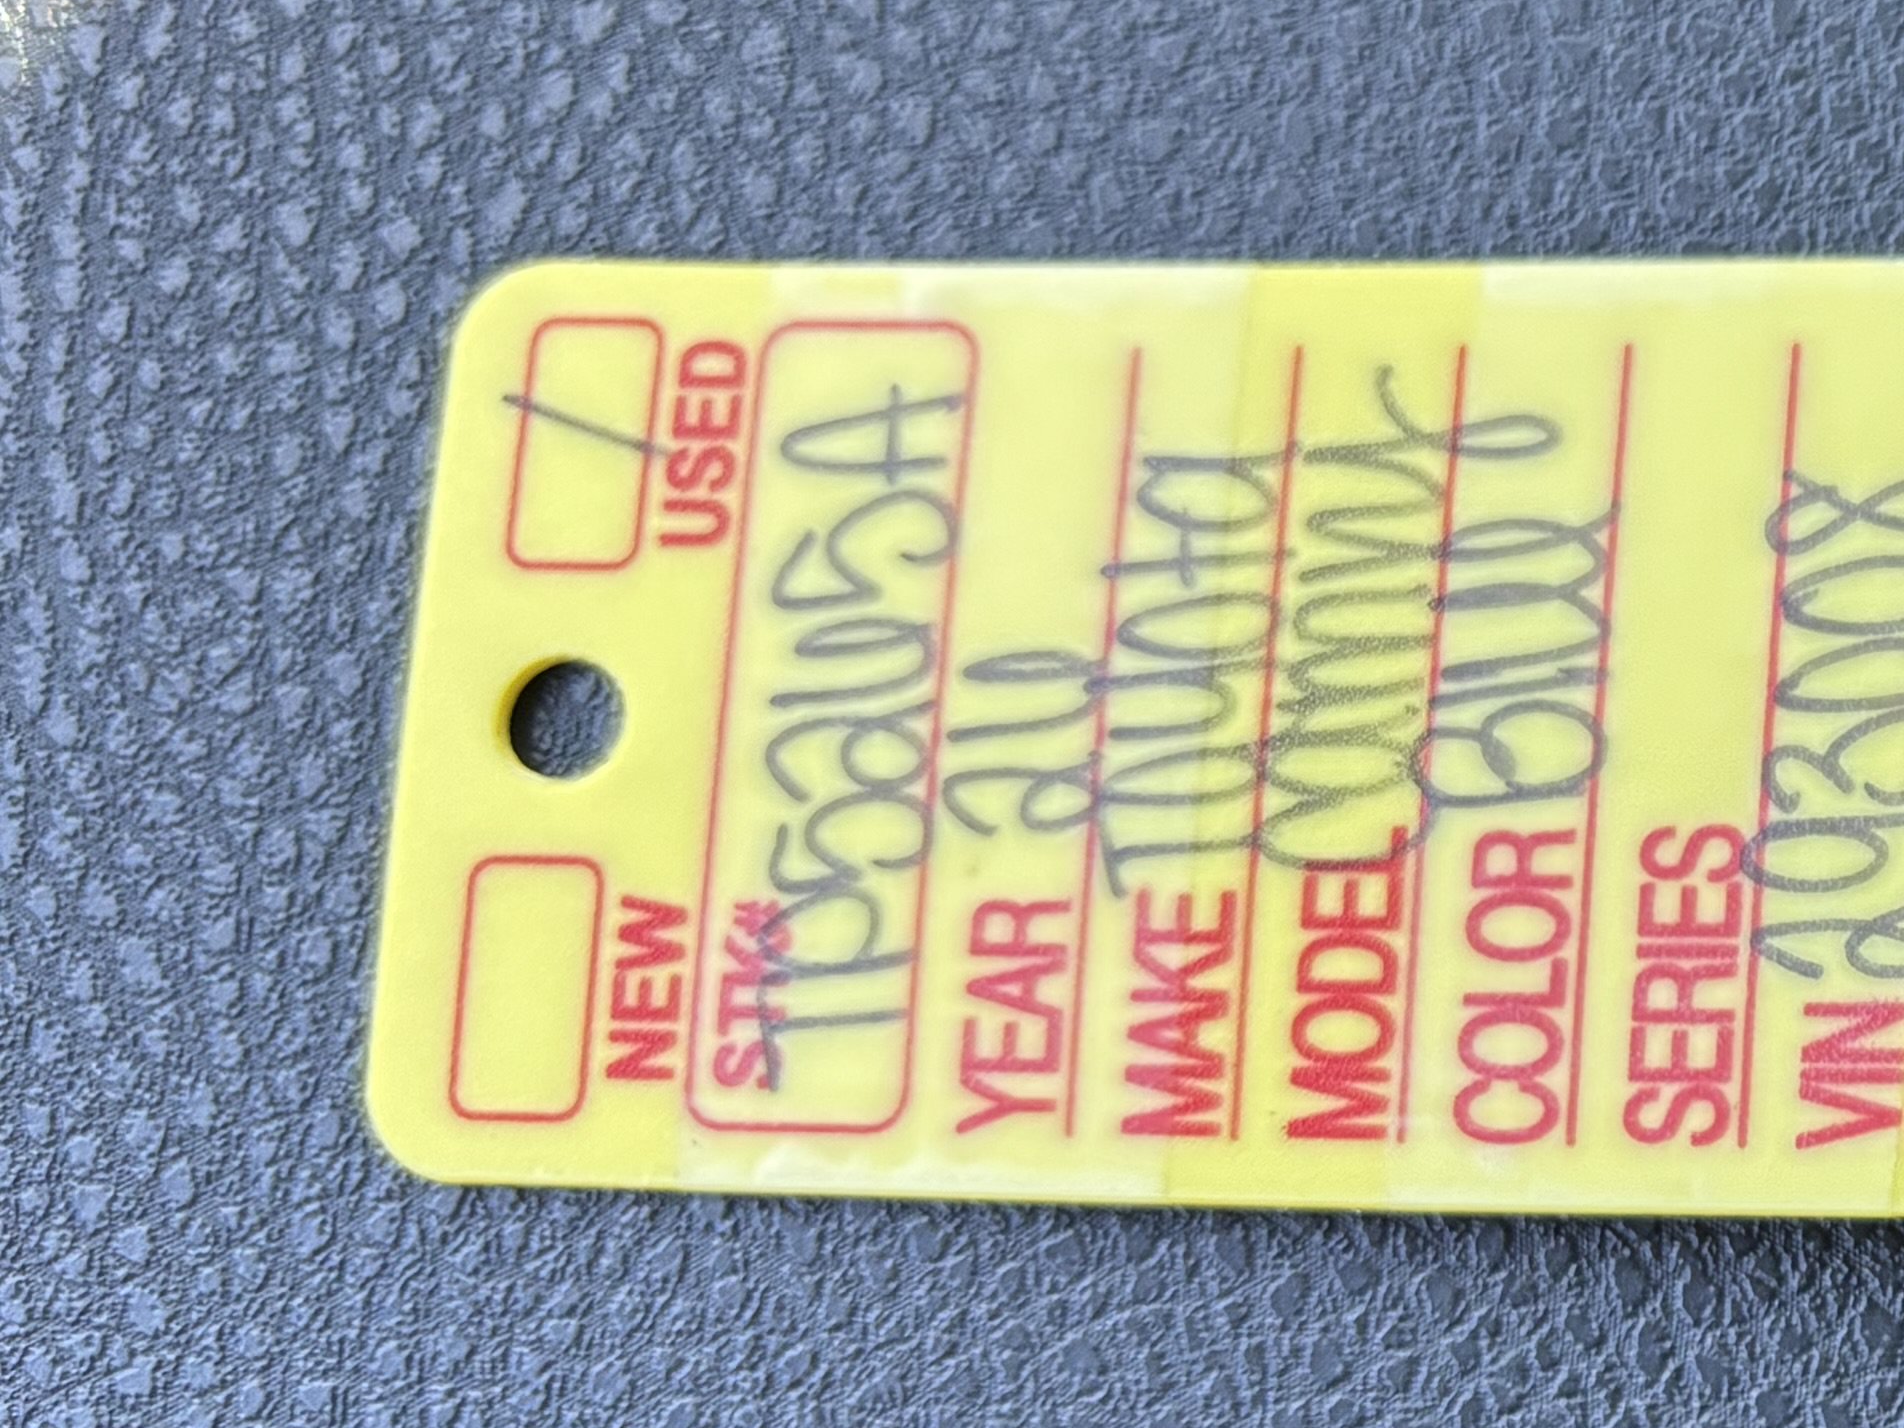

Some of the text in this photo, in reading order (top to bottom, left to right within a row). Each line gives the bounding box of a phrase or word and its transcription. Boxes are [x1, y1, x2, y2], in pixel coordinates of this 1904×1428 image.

[658, 339, 750, 547] USED
[945, 650, 1105, 833] 26
[1084, 444, 1298, 899] Toyota
[1411, 500, 1620, 808] Blue
[605, 894, 691, 1080] NEW
[714, 900, 794, 1089] STK#
[956, 898, 1070, 1133] YEAR
[1120, 887, 1237, 1138] MAKE
[1284, 825, 1408, 1141] MODEL
[1453, 827, 1577, 1145] COLOR
[1623, 822, 1744, 1147] SERIES
